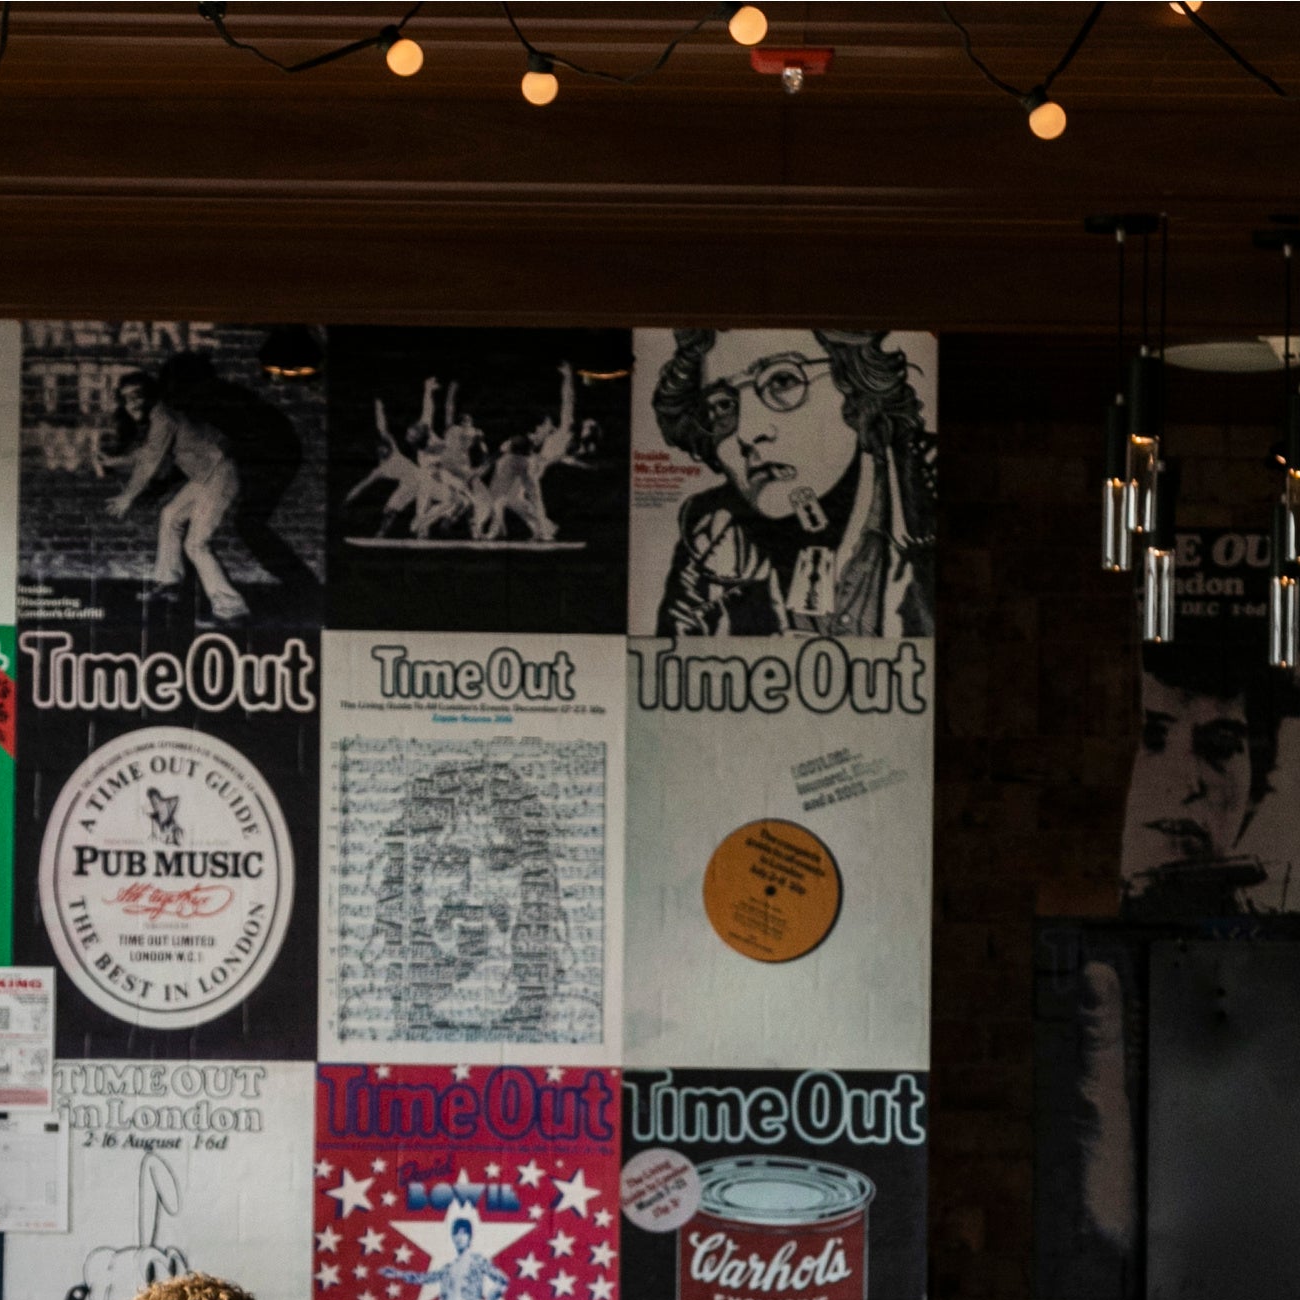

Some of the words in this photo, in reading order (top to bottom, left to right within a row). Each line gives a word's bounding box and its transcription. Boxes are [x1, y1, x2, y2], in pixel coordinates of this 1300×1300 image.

[1212, 533, 1272, 568] OU
[19, 631, 185, 711] Time
[185, 632, 317, 712] Out
[371, 645, 486, 699] Time
[486, 646, 575, 701] Out
[627, 635, 792, 713] Time
[795, 635, 927, 714] Out
[79, 818, 97, 834] A
[93, 761, 145, 813] TIME
[149, 755, 201, 779] OUT
[204, 770, 261, 841] GUIDE
[72, 845, 147, 878] PUB
[153, 850, 264, 879] MUSIC
[68, 895, 100, 950] THE
[93, 951, 153, 1000] BEST
[163, 982, 189, 1002] IN
[199, 901, 266, 995] LONDON
[118, 934, 145, 947] TIME
[146, 934, 169, 947] OUT
[171, 934, 216, 948] LIMITED
[129, 951, 173, 963] LONDON
[54, 1062, 166, 1097] TIME
[170, 1065, 267, 1099] OUT
[58, 1100, 99, 1131] in
[104, 1100, 262, 1132] London
[316, 1063, 481, 1140] Time
[484, 1064, 614, 1142] Out
[622, 1069, 788, 1143] Time
[791, 1069, 926, 1145] Out
[123, 1132, 181, 1151] August
[407, 1180, 521, 1211] BOWIE
